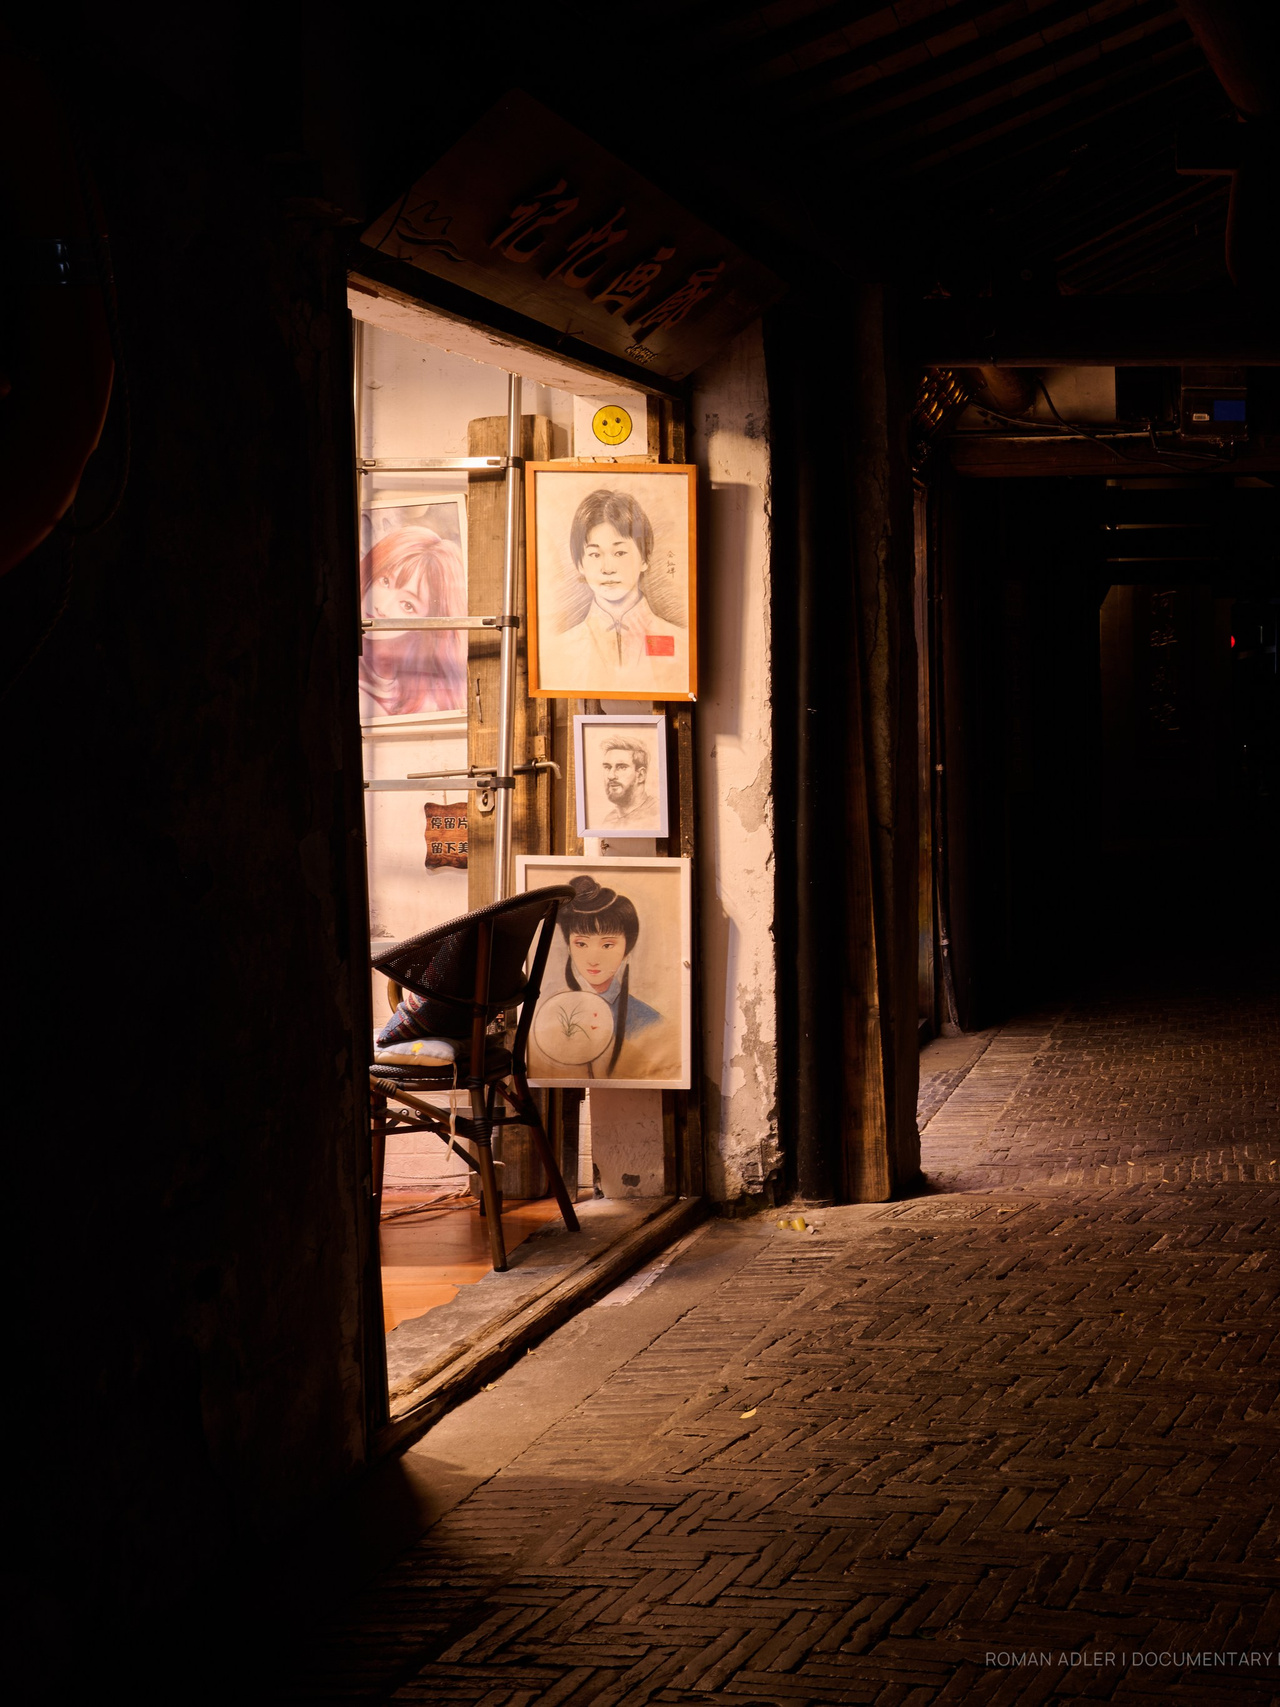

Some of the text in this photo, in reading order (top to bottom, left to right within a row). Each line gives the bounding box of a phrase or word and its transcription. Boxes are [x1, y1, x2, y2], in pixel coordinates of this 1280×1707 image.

[488, 177, 727, 335] 记忆画廊
[430, 816, 468, 830] 停留片
[431, 841, 468, 855] 留下美
